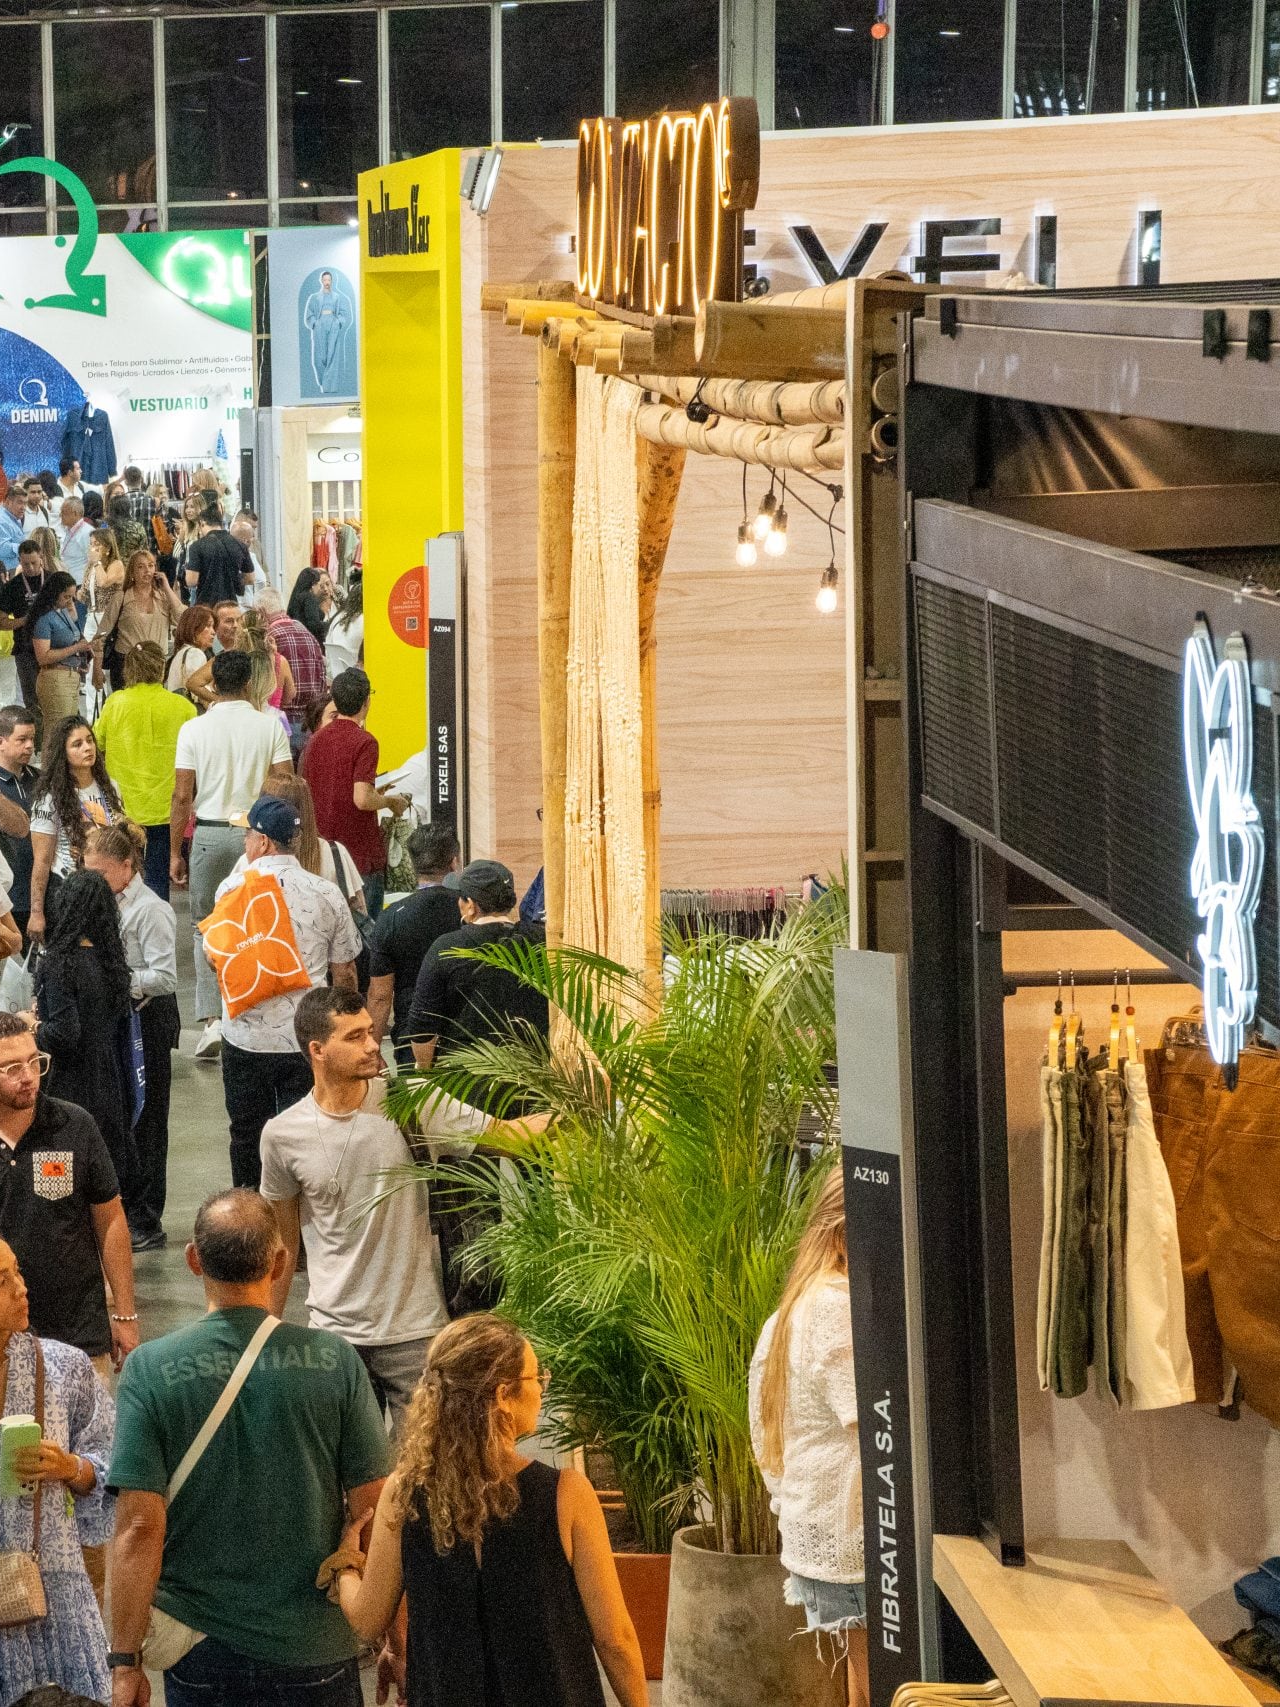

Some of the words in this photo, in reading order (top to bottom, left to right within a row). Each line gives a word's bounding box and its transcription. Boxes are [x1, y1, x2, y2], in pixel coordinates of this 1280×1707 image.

[81, 360, 104, 368] Driles
[109, 359, 129, 367] Telas
[130, 359, 148, 368] para
[148, 357, 183, 366] Sublimar
[87, 370, 109, 379] Driles
[129, 396, 208, 412] VESTUARIO
[11, 407, 58, 424] DENIM
[438, 725, 449, 754] SAS
[438, 756, 449, 804] TEXELI
[853, 1166, 890, 1185] AZ130
[873, 1390, 893, 1454] S.A.
[877, 1463, 903, 1654] FIBRATELA
